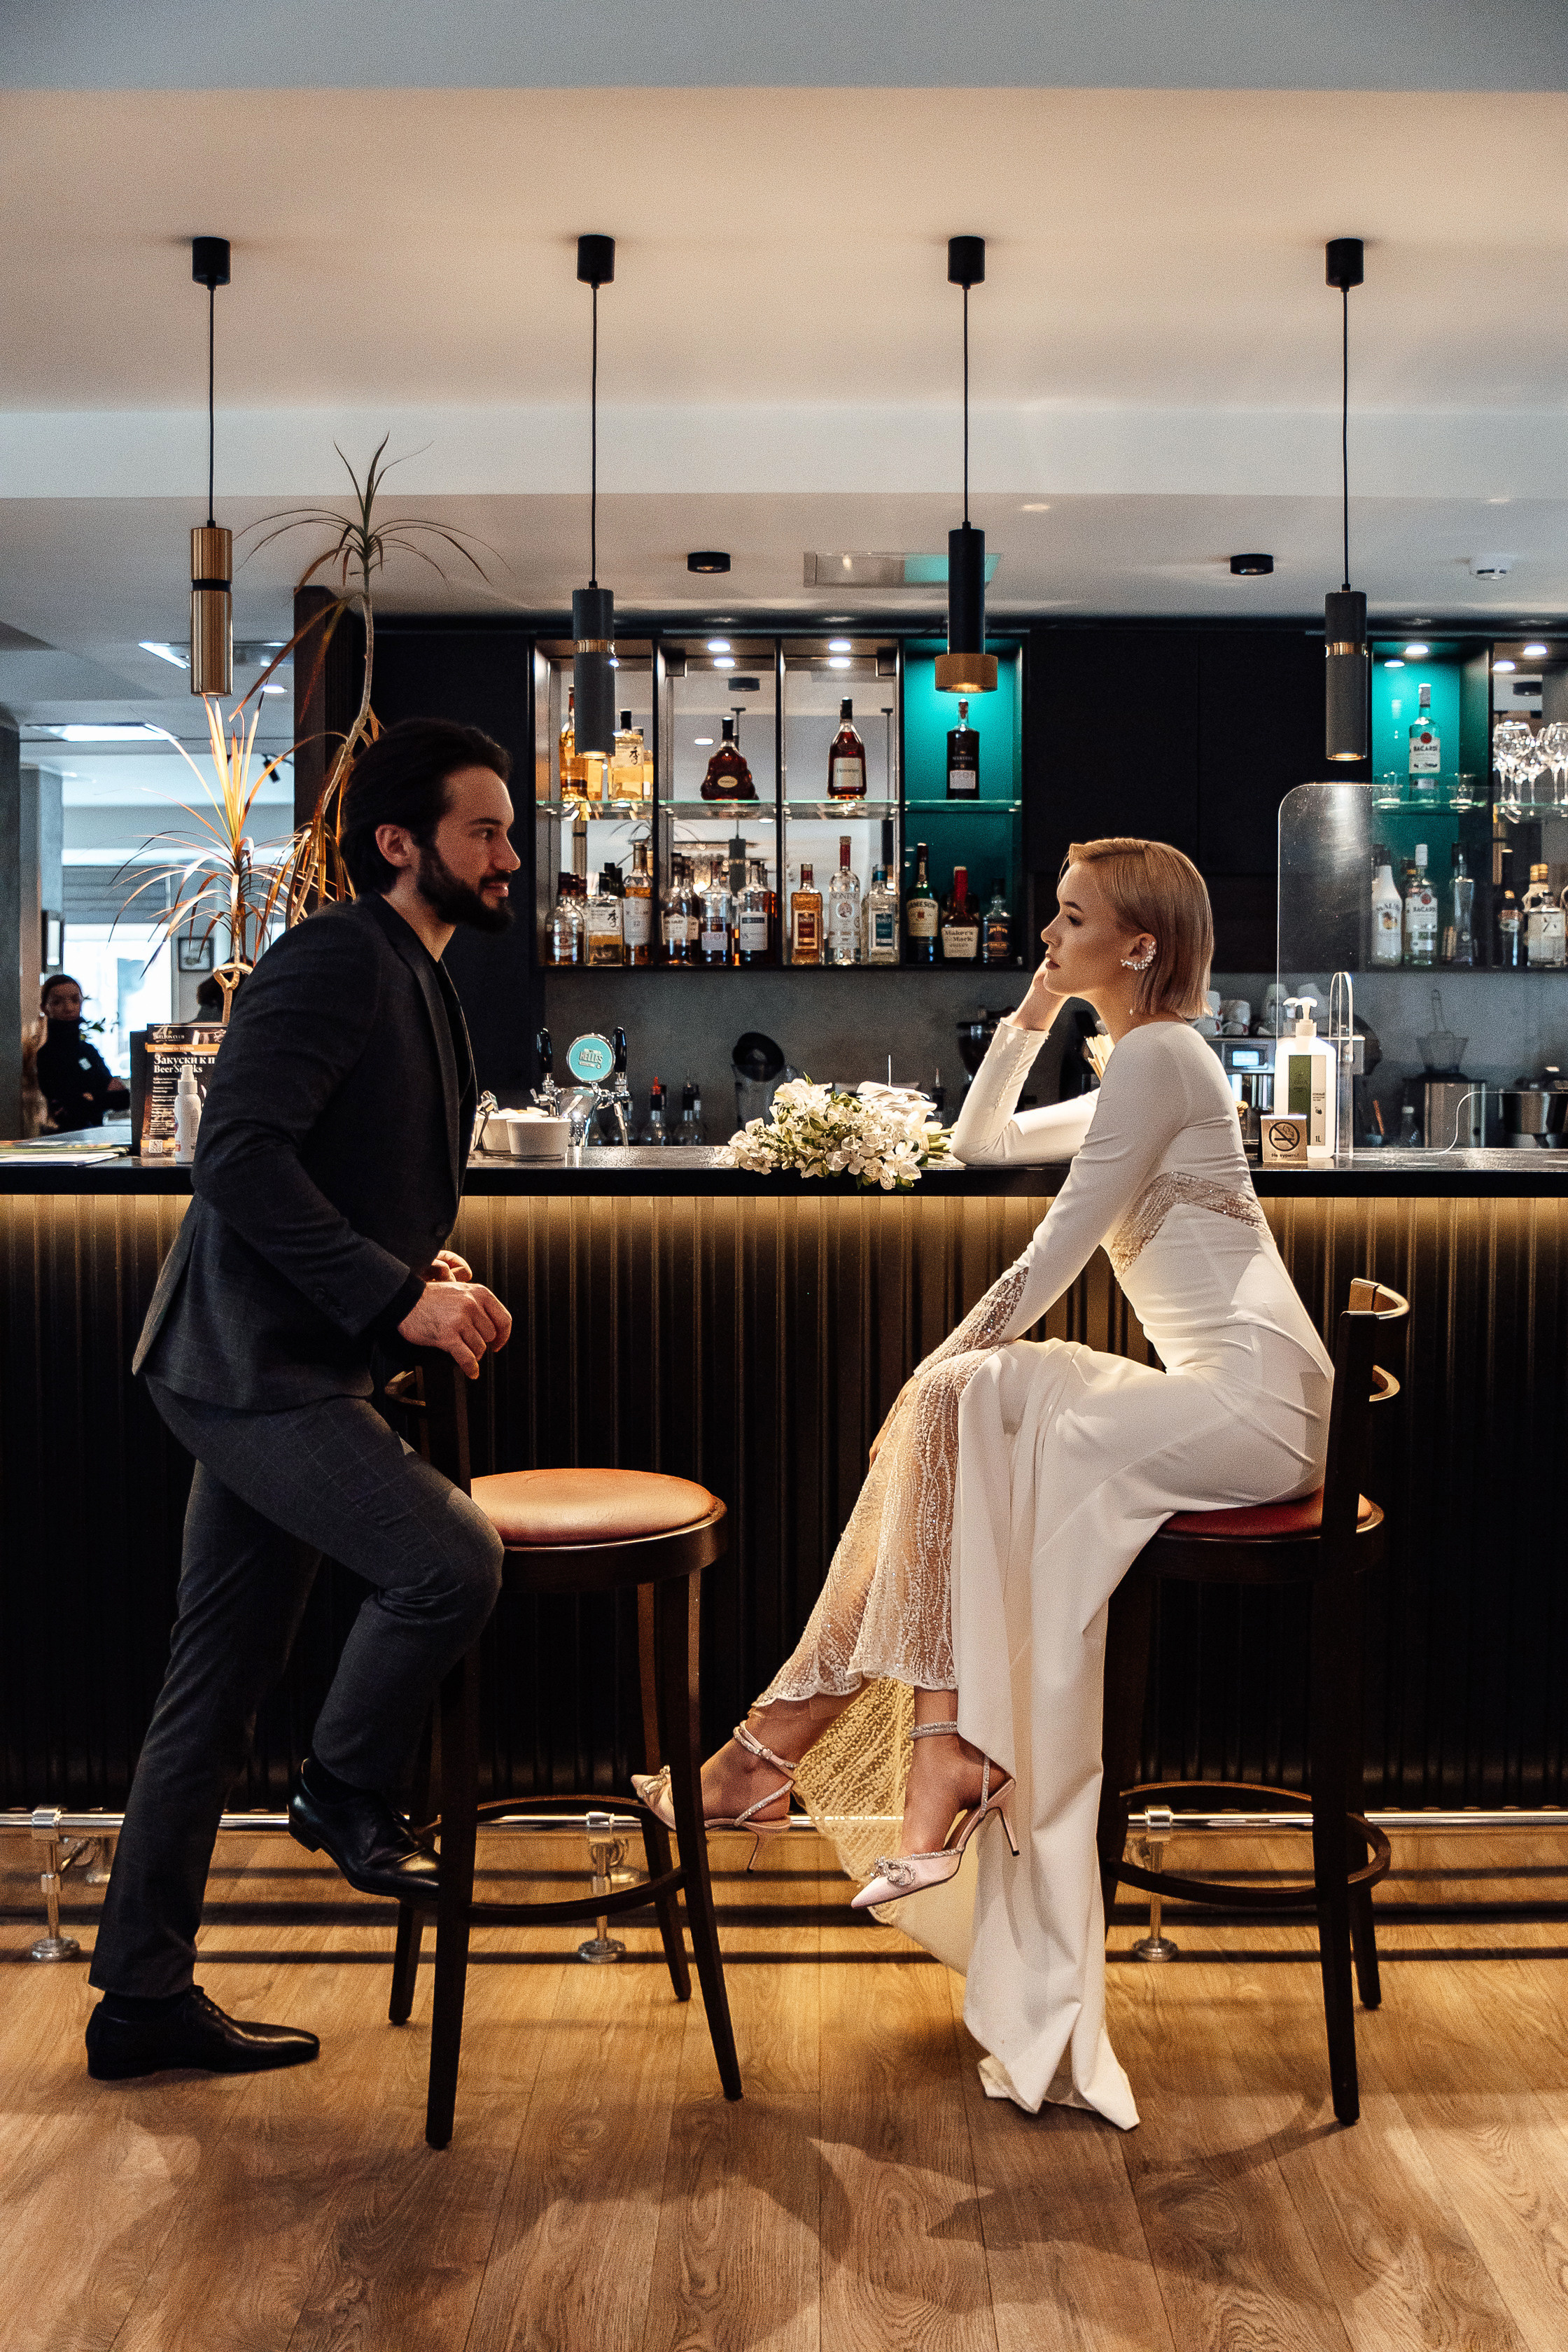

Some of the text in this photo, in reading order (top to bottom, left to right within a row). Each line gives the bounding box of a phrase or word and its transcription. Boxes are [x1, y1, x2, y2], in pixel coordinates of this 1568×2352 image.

[154, 1052, 197, 1066] Закуски
[154, 1064, 203, 1073] Beer Snks
